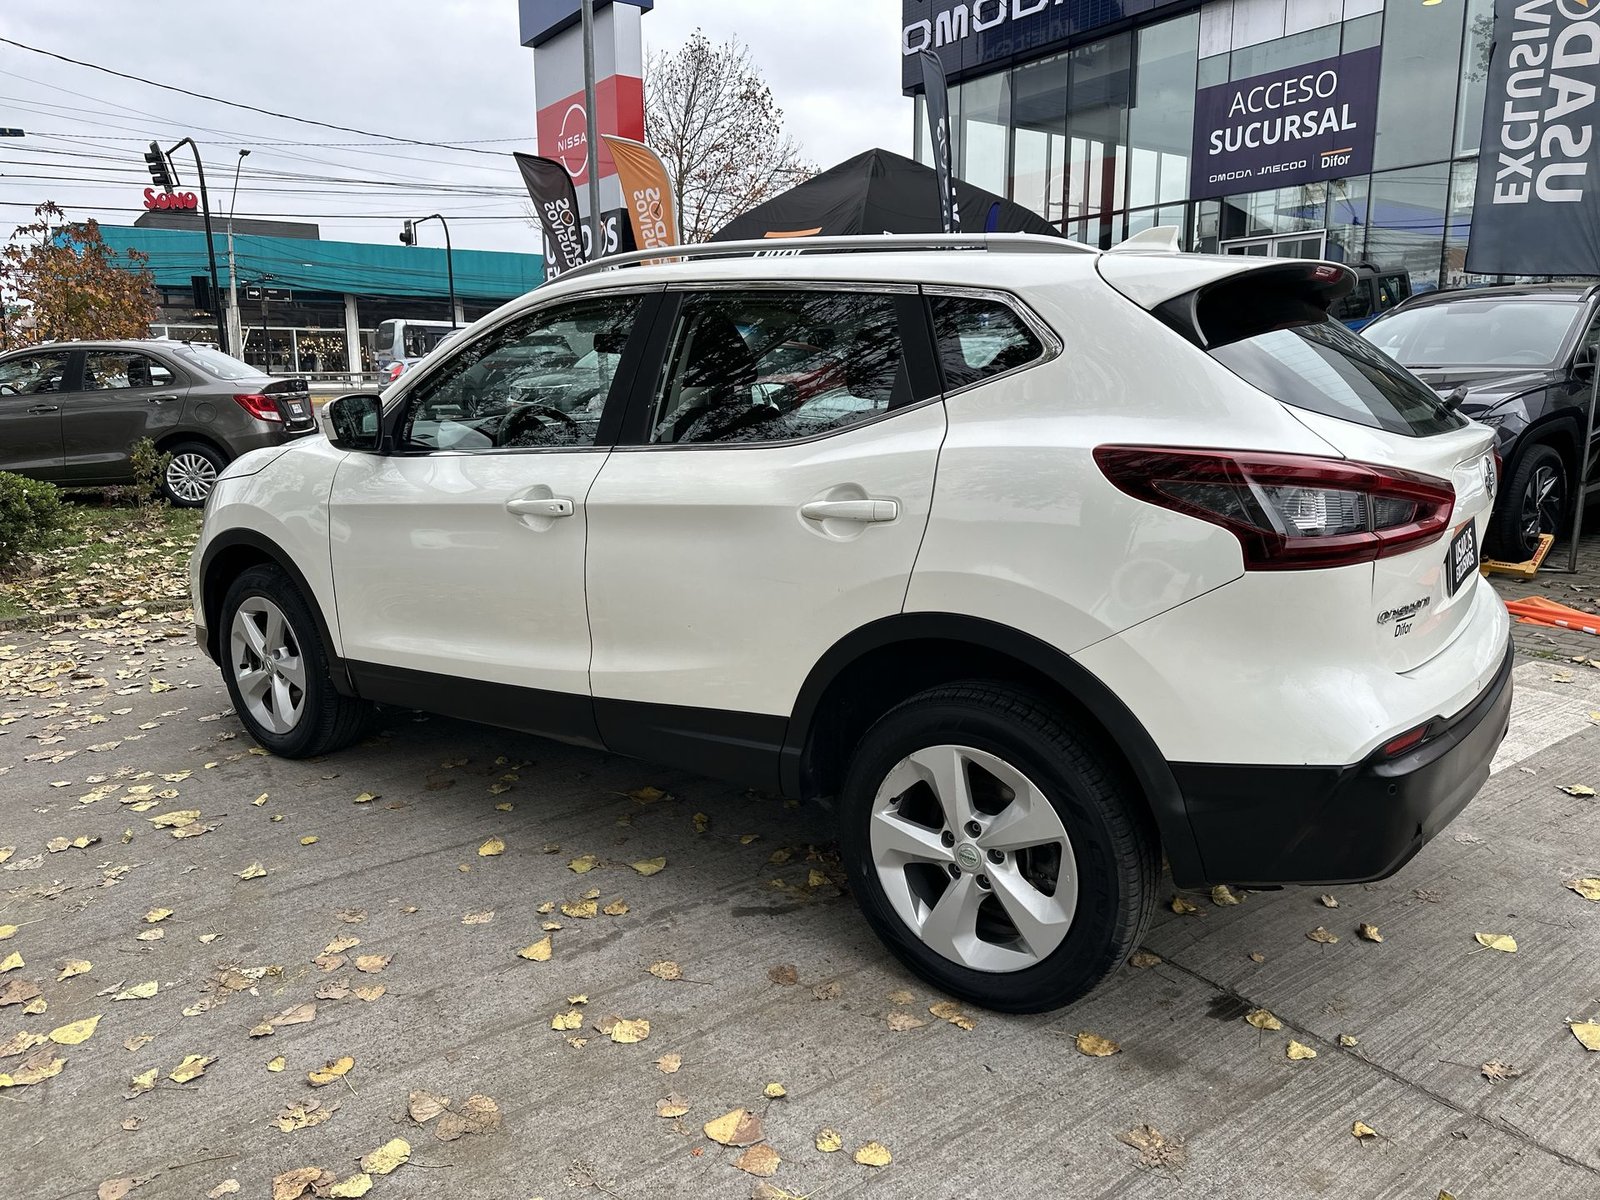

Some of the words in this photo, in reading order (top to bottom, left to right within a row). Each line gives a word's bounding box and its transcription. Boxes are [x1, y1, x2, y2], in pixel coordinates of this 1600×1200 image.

[902, 0, 1064, 56] OMOD
[1228, 70, 1338, 118] ACCESO
[557, 132, 588, 153] NISSA
[1208, 103, 1357, 155] SUCURSAL
[1208, 169, 1253, 183] OMODA
[1257, 159, 1307, 176] JAECOO
[1320, 153, 1351, 169] Difor
[143, 187, 198, 209] SONO
[1394, 622, 1413, 638] Difor
